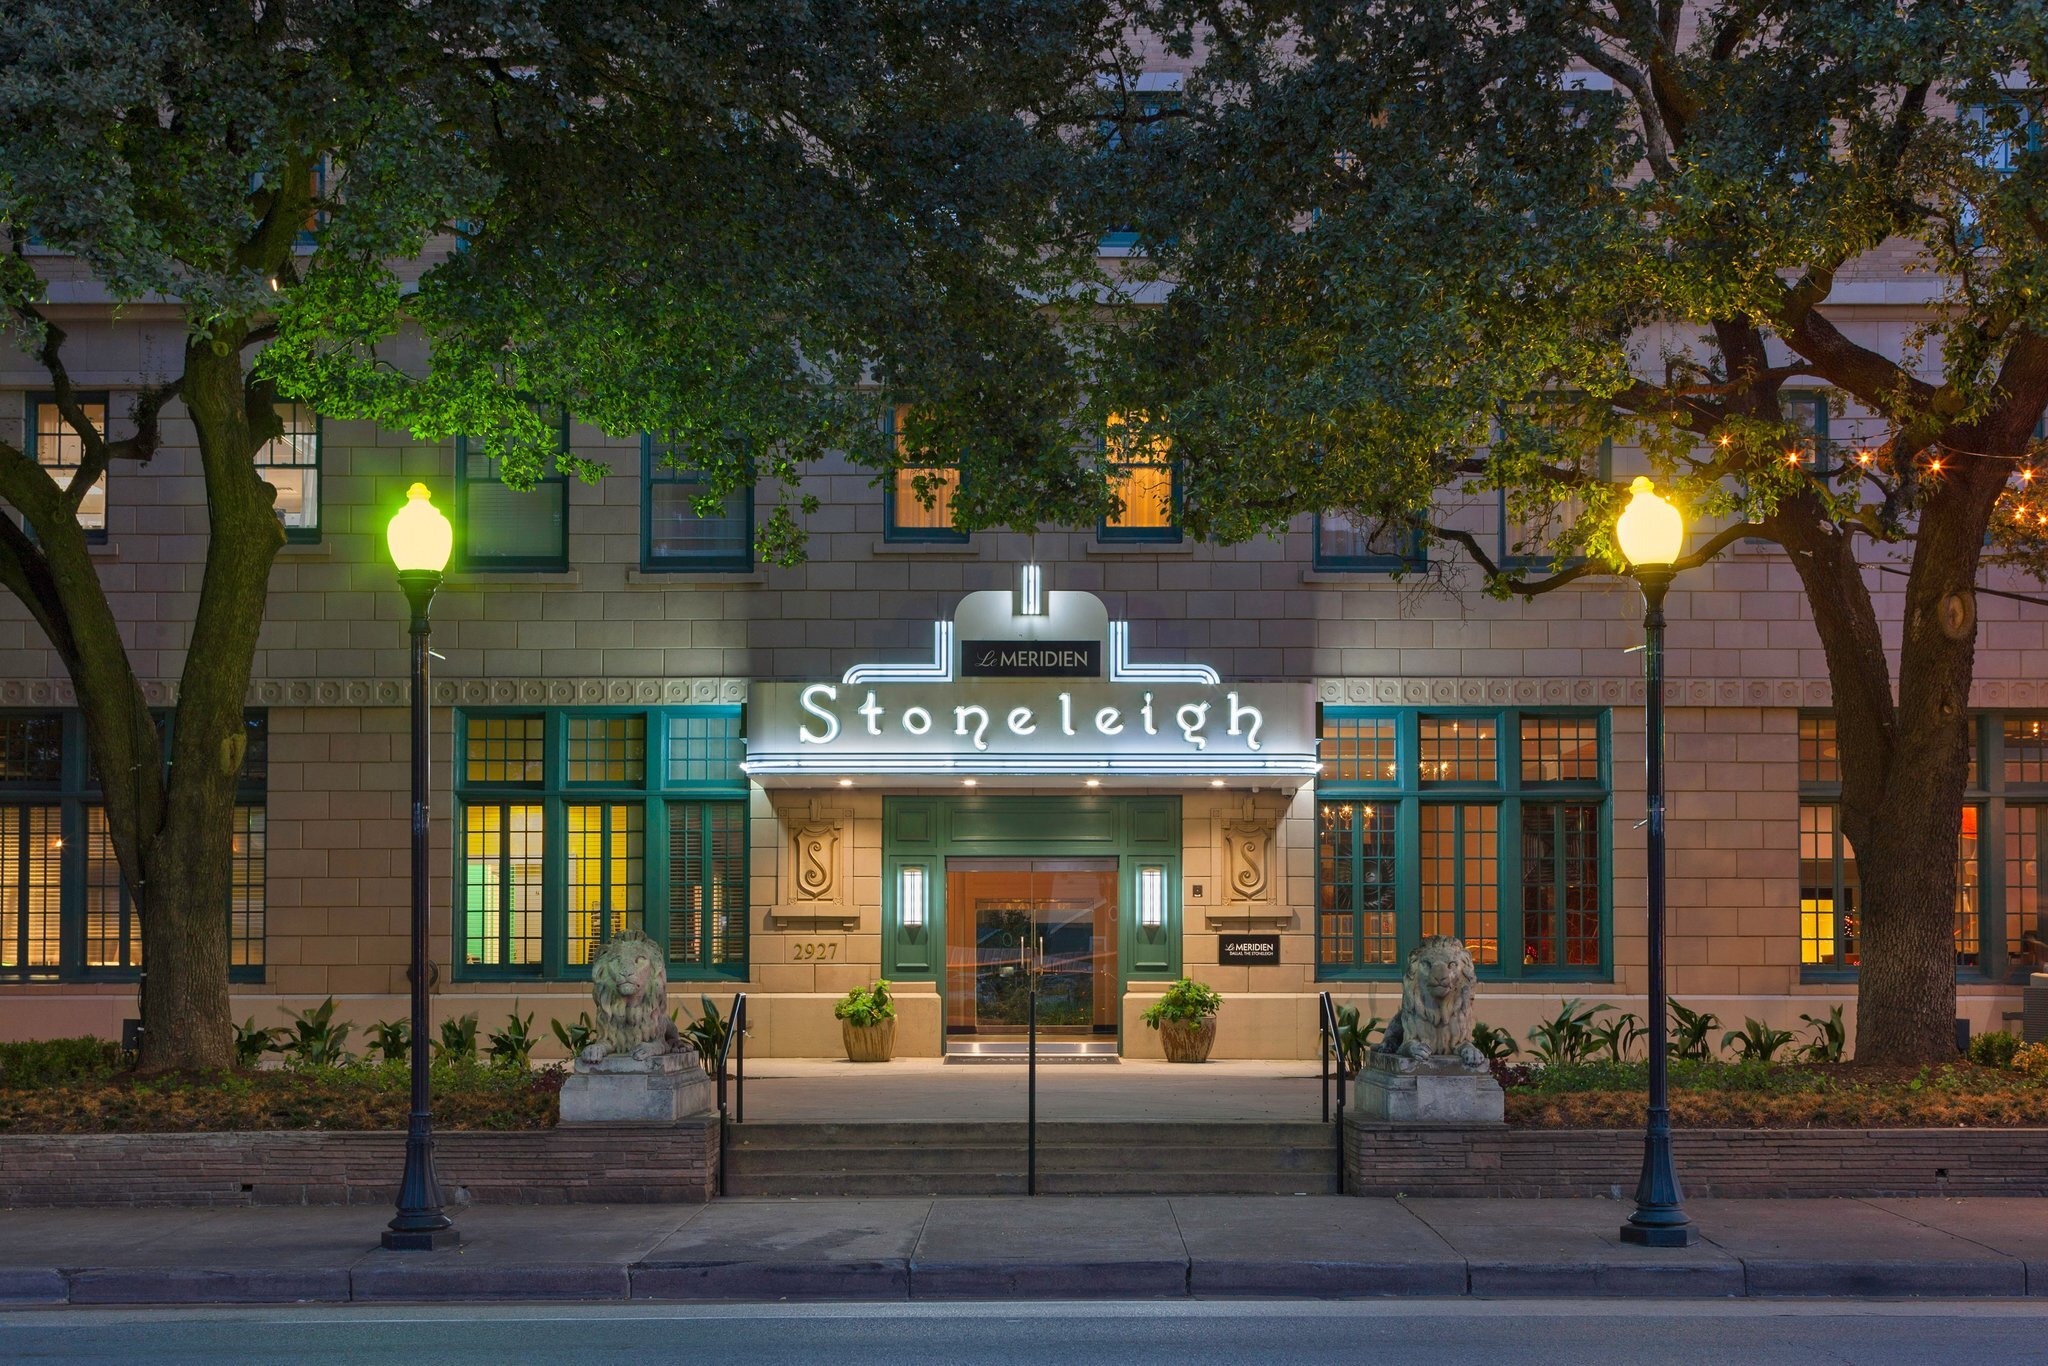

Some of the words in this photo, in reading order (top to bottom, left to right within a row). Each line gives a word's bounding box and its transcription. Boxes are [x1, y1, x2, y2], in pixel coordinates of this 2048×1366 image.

[975, 649, 998, 668] Le
[1000, 650, 1088, 667] MERIDIEN
[800, 684, 1263, 751] Stoneleigh
[793, 943, 838, 960] 2927
[1235, 943, 1274, 951] MERIDIEN
